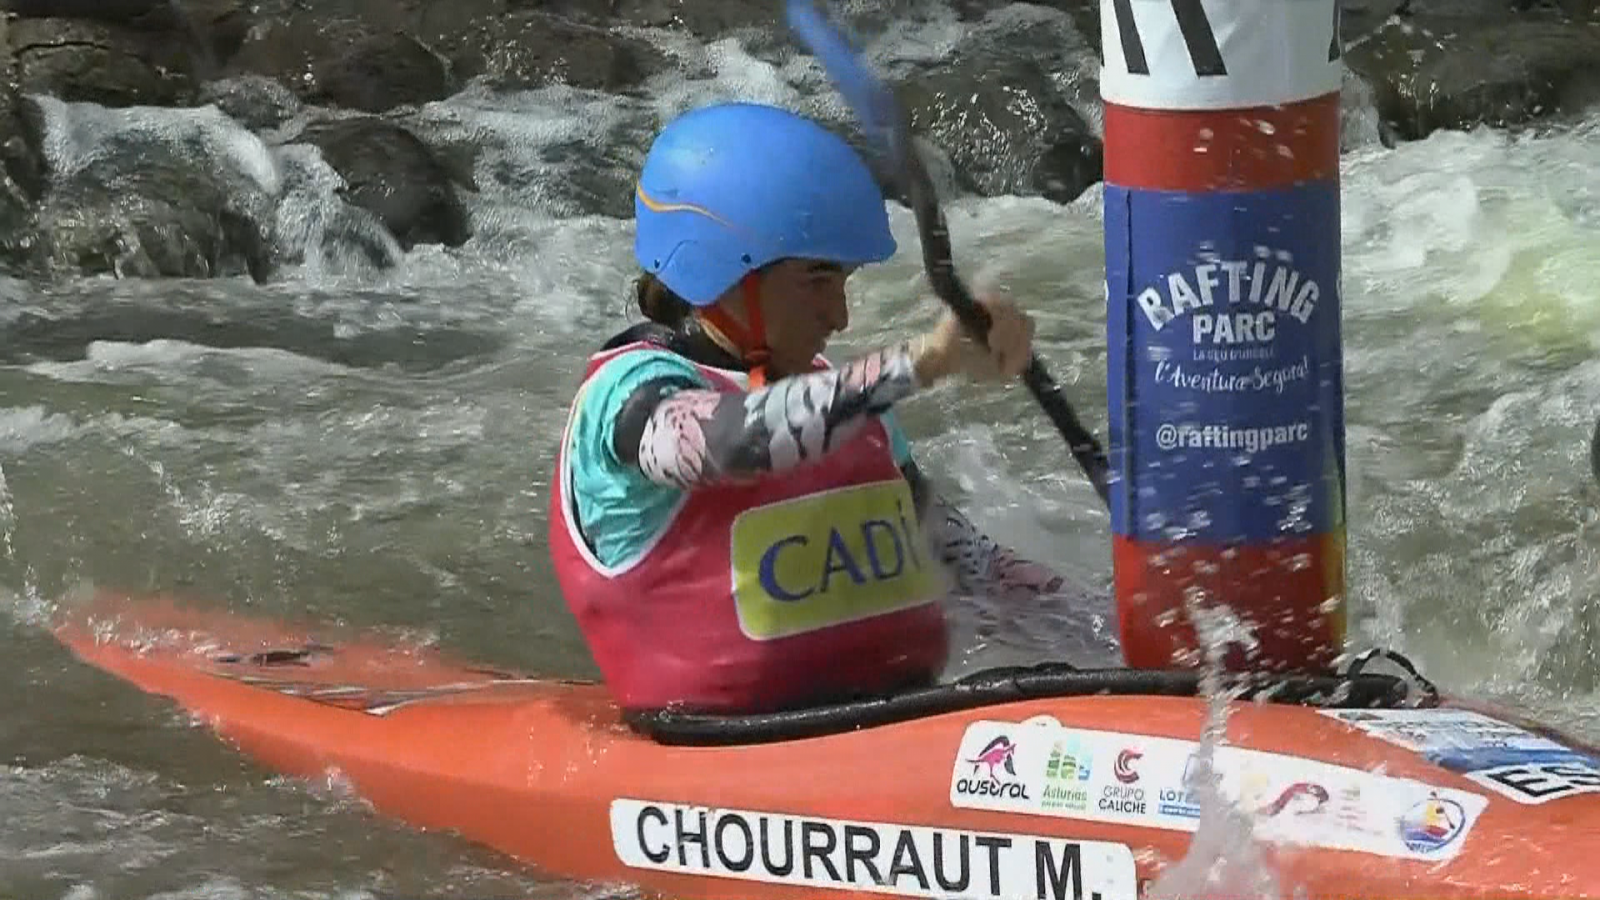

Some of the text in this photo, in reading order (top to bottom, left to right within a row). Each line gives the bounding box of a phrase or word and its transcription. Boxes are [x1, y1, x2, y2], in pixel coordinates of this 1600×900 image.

[1137, 261, 1320, 331] RAFTING
[1192, 311, 1276, 344] PARC
[1156, 422, 1308, 453] @raftingparc
[1098, 798, 1147, 815] CALICHE
[1103, 785, 1145, 801] GRUPO
[636, 805, 1013, 897] CHOURRAUT
